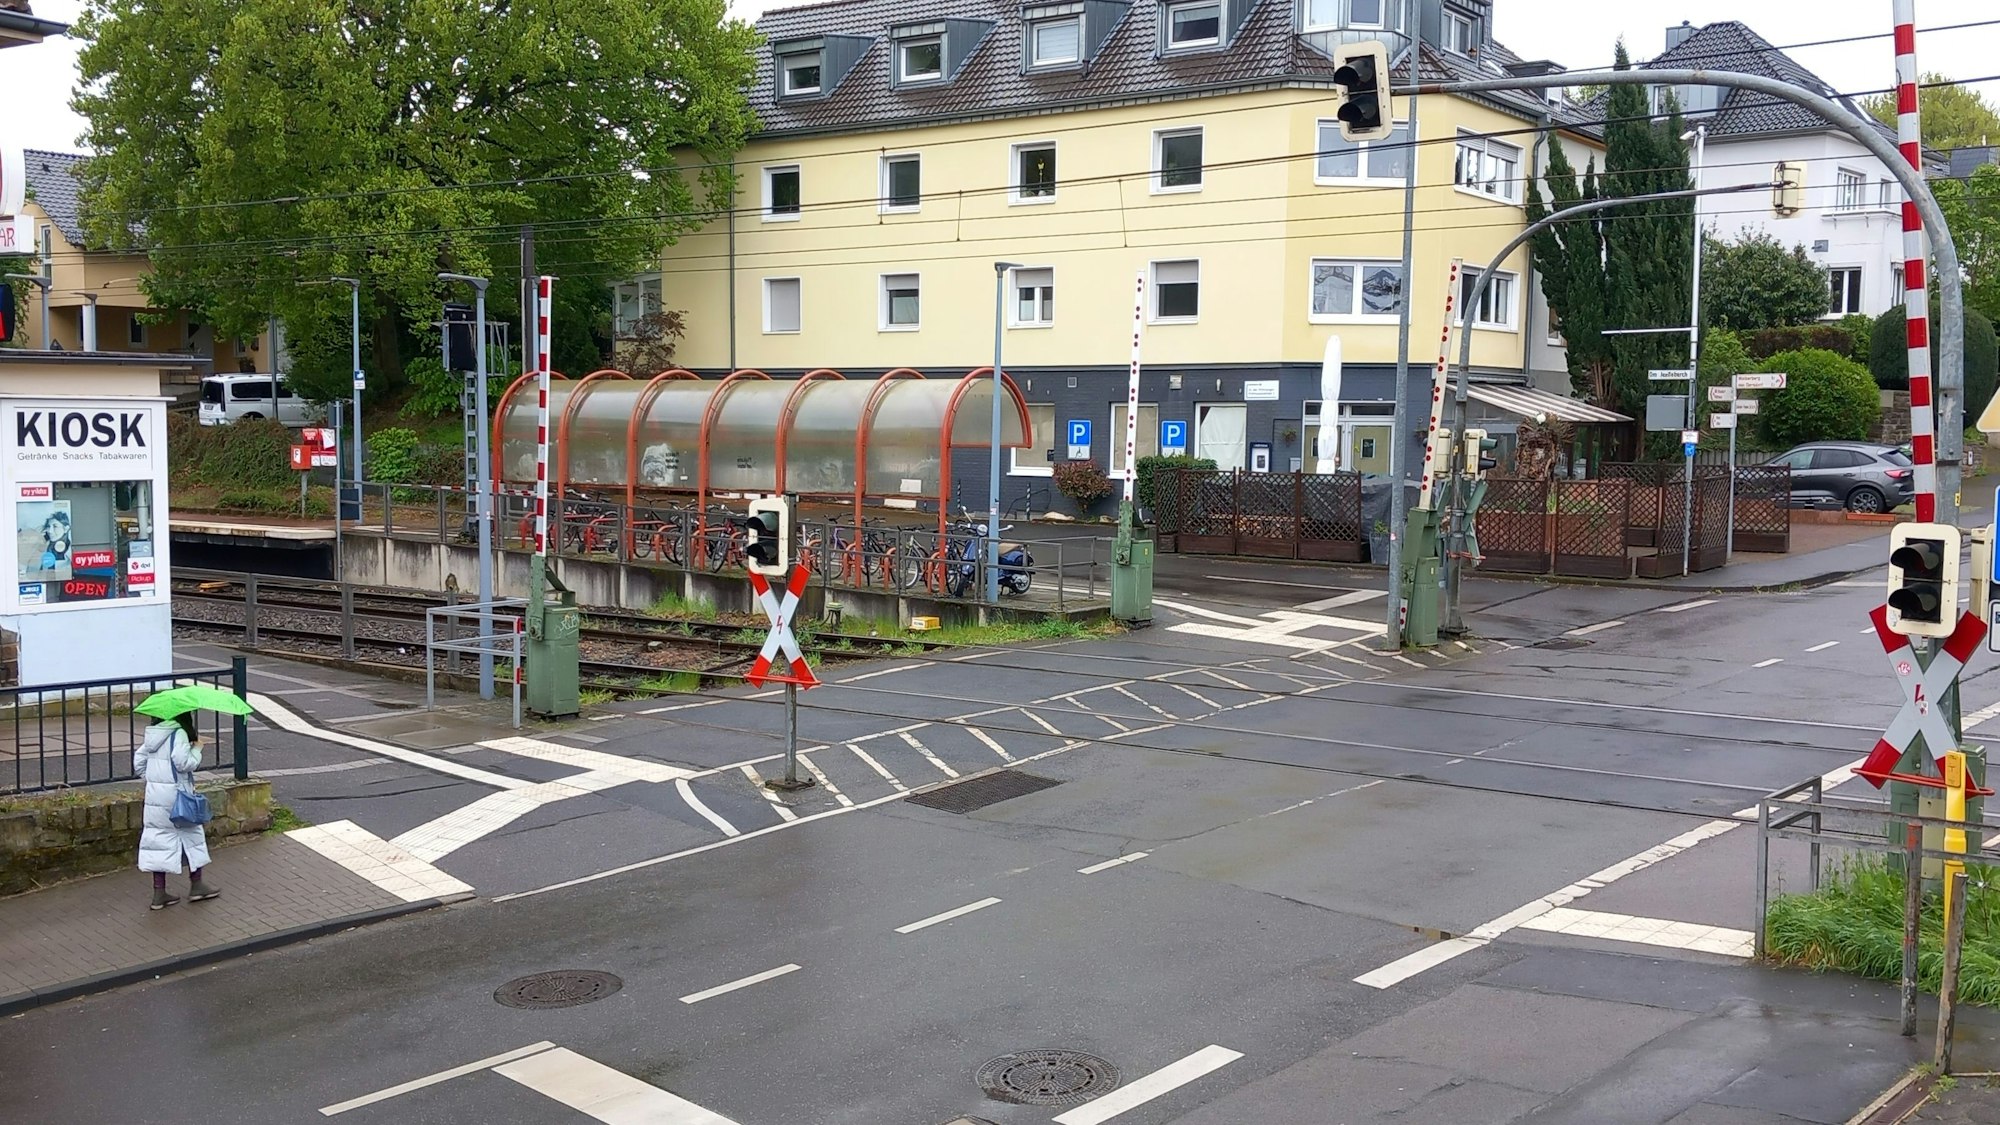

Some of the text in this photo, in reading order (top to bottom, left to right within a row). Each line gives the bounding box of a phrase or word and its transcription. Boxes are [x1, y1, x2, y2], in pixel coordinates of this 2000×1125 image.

[16, 411, 146, 447] KIOSK
[1073, 424, 1086, 444] P
[1167, 424, 1181, 445] P
[17, 452, 148, 461] Getränke Snacks Tabakwaren
[75, 556, 87, 566] ay
[65, 582, 107, 596] OPEN
